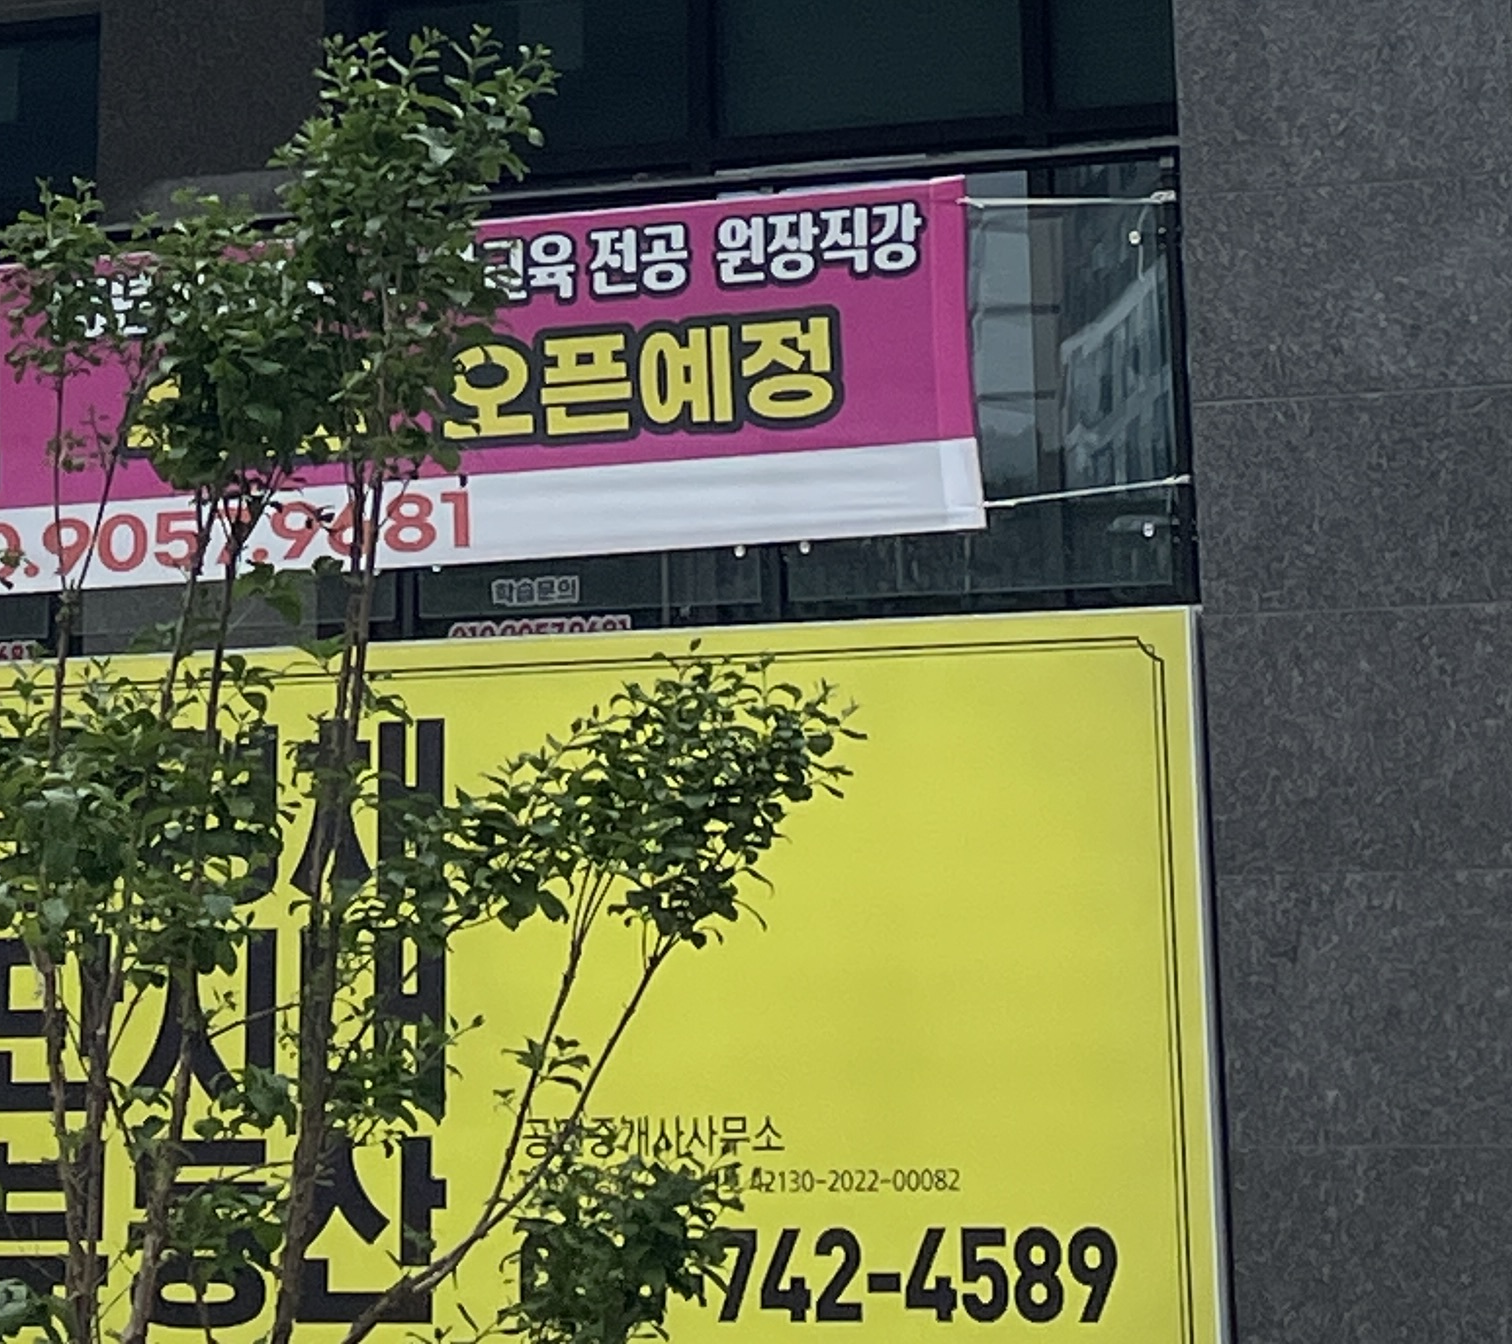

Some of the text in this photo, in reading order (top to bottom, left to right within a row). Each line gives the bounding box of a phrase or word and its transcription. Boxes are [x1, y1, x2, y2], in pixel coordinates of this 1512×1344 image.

[589, 224, 688, 295] 전공
[716, 203, 922, 284] 원장직강
[444, 316, 835, 440] 오픈예정
[521, 1226, 1119, 1326] 742-4589
